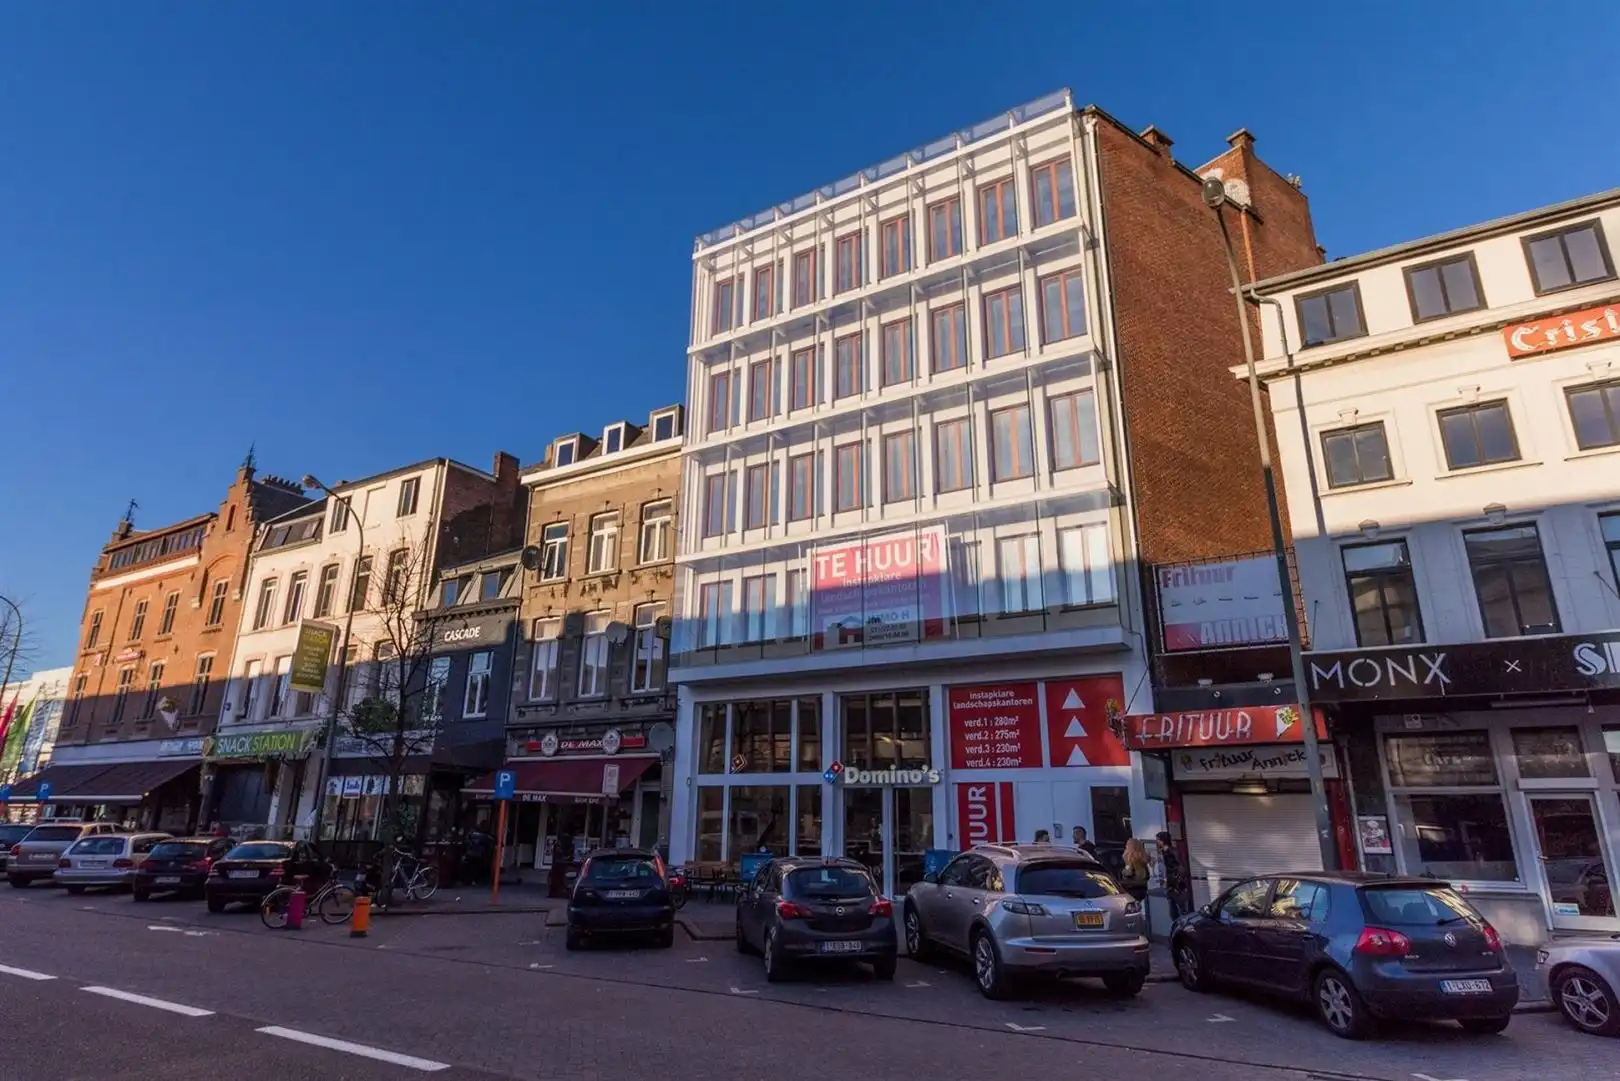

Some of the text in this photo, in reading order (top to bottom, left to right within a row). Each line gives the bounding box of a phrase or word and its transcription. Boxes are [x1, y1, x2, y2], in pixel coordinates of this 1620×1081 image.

[816, 532, 938, 580] TE HUUR
[444, 626, 481, 642] CASCADE
[1311, 653, 1452, 690] MONX
[953, 698, 1033, 710] landschapskantoren
[964, 717, 988, 728] verd.1
[1135, 711, 1251, 745] FRITUUR
[217, 737, 250, 754] SNACK
[250, 732, 296, 750] STATION
[965, 730, 989, 741] verd.2
[965, 744, 990, 754] verd.3
[966, 757, 991, 768] verd.4
[500, 772, 511, 787] P
[844, 764, 940, 785] Domino's
[40, 783, 49, 793] P
